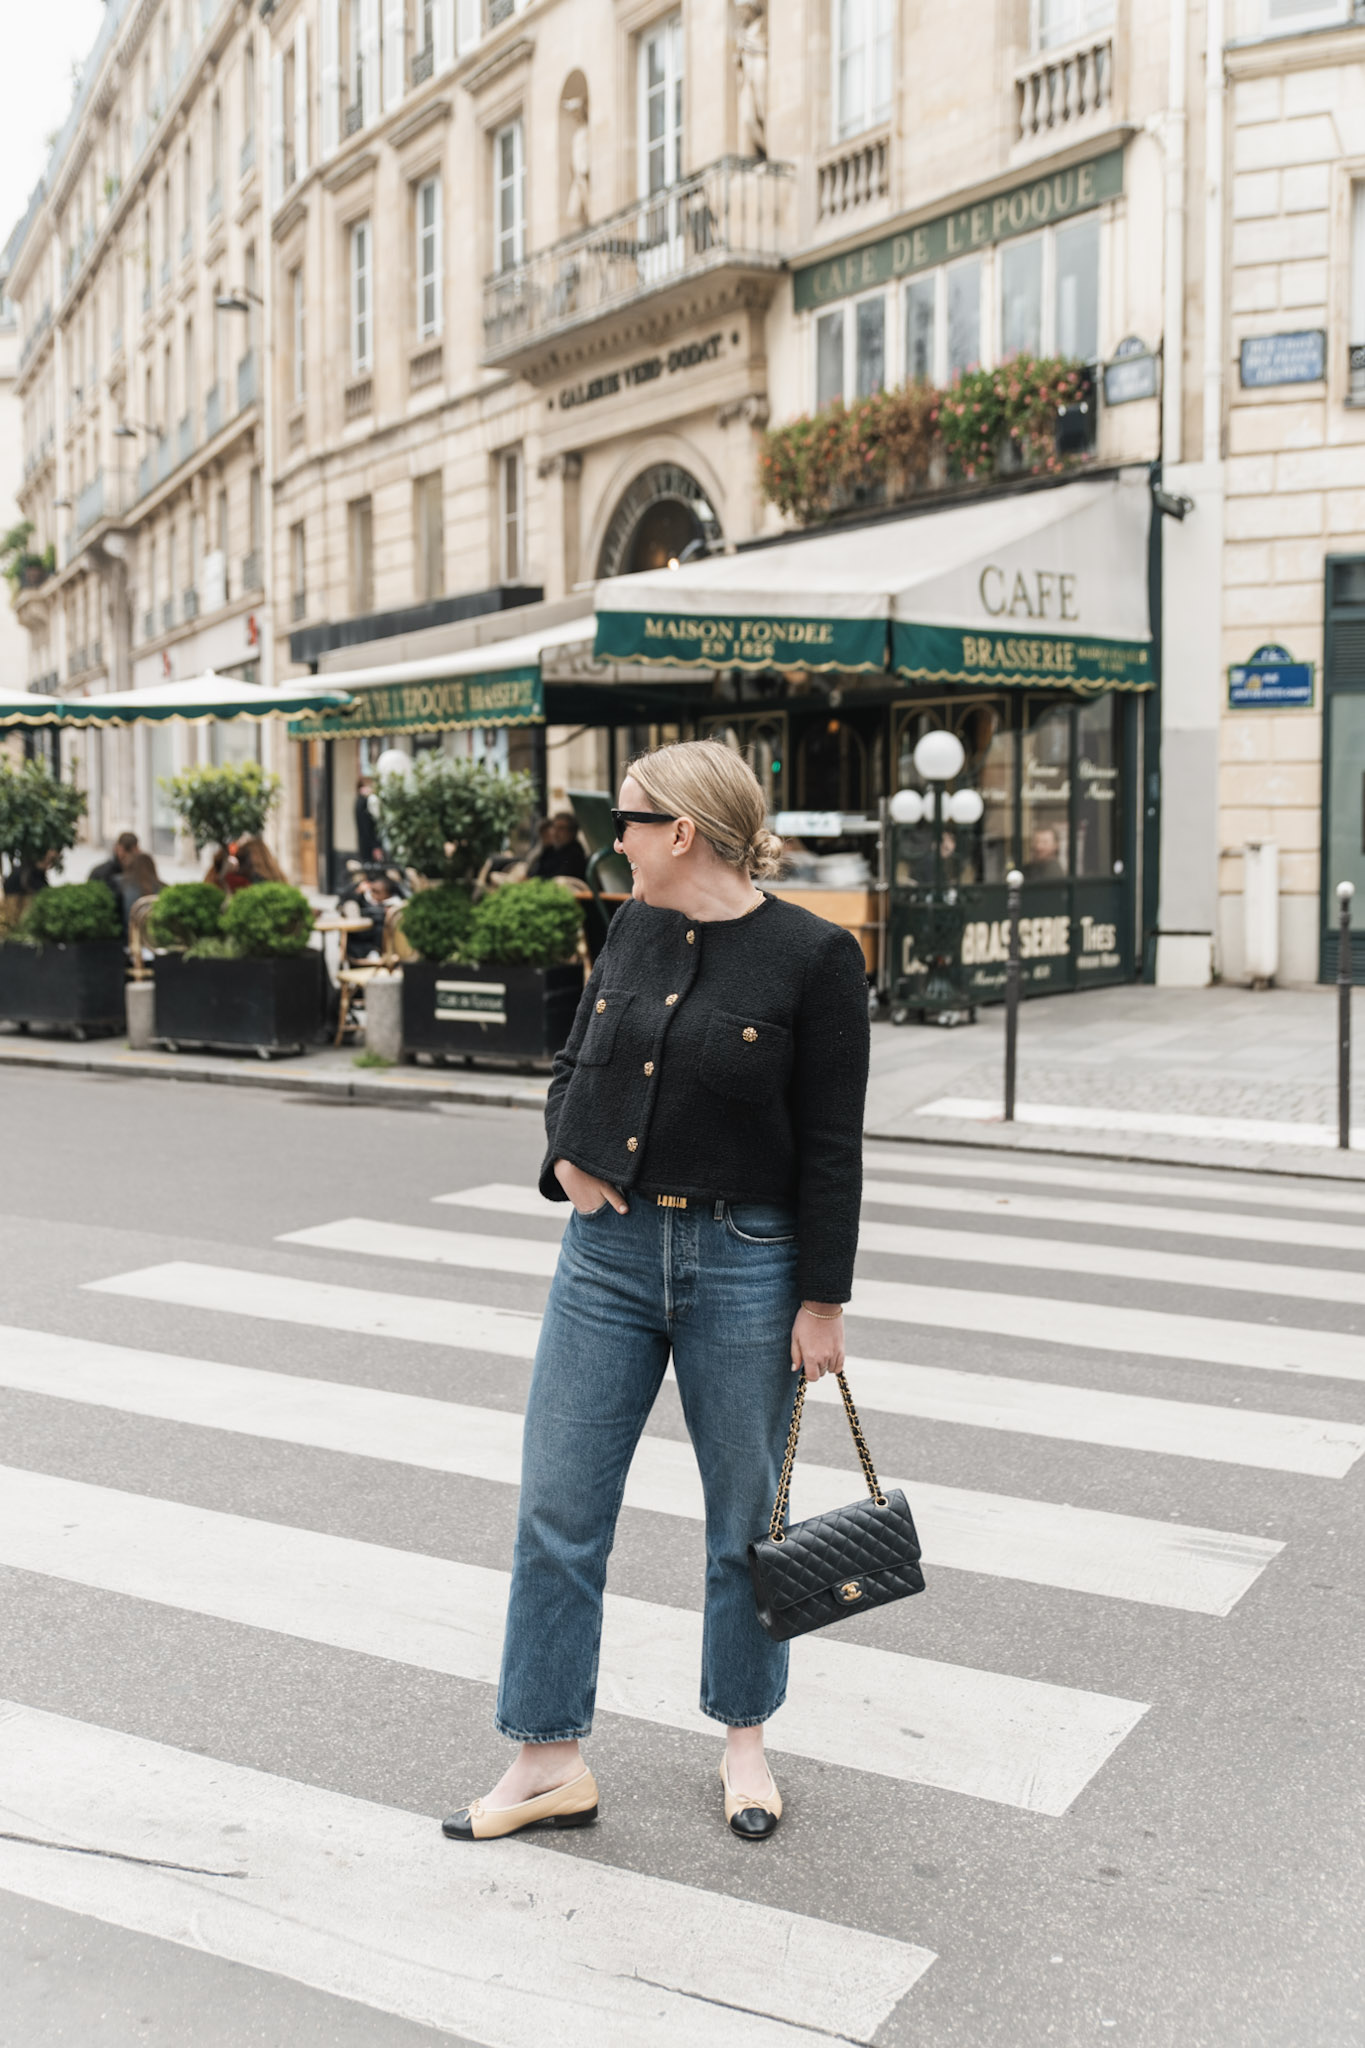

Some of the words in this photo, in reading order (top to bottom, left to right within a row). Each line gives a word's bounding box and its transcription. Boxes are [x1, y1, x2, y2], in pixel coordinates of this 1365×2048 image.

[811, 247, 877, 300] CAFE
[892, 226, 930, 272] DE
[946, 162, 1097, 252] L'EPOQUE
[979, 564, 1079, 622] CAFE
[644, 617, 735, 641] MAISON
[740, 621, 834, 644] FONDEE
[701, 639, 726, 657] EN
[961, 635, 1077, 673] BRASSERIE
